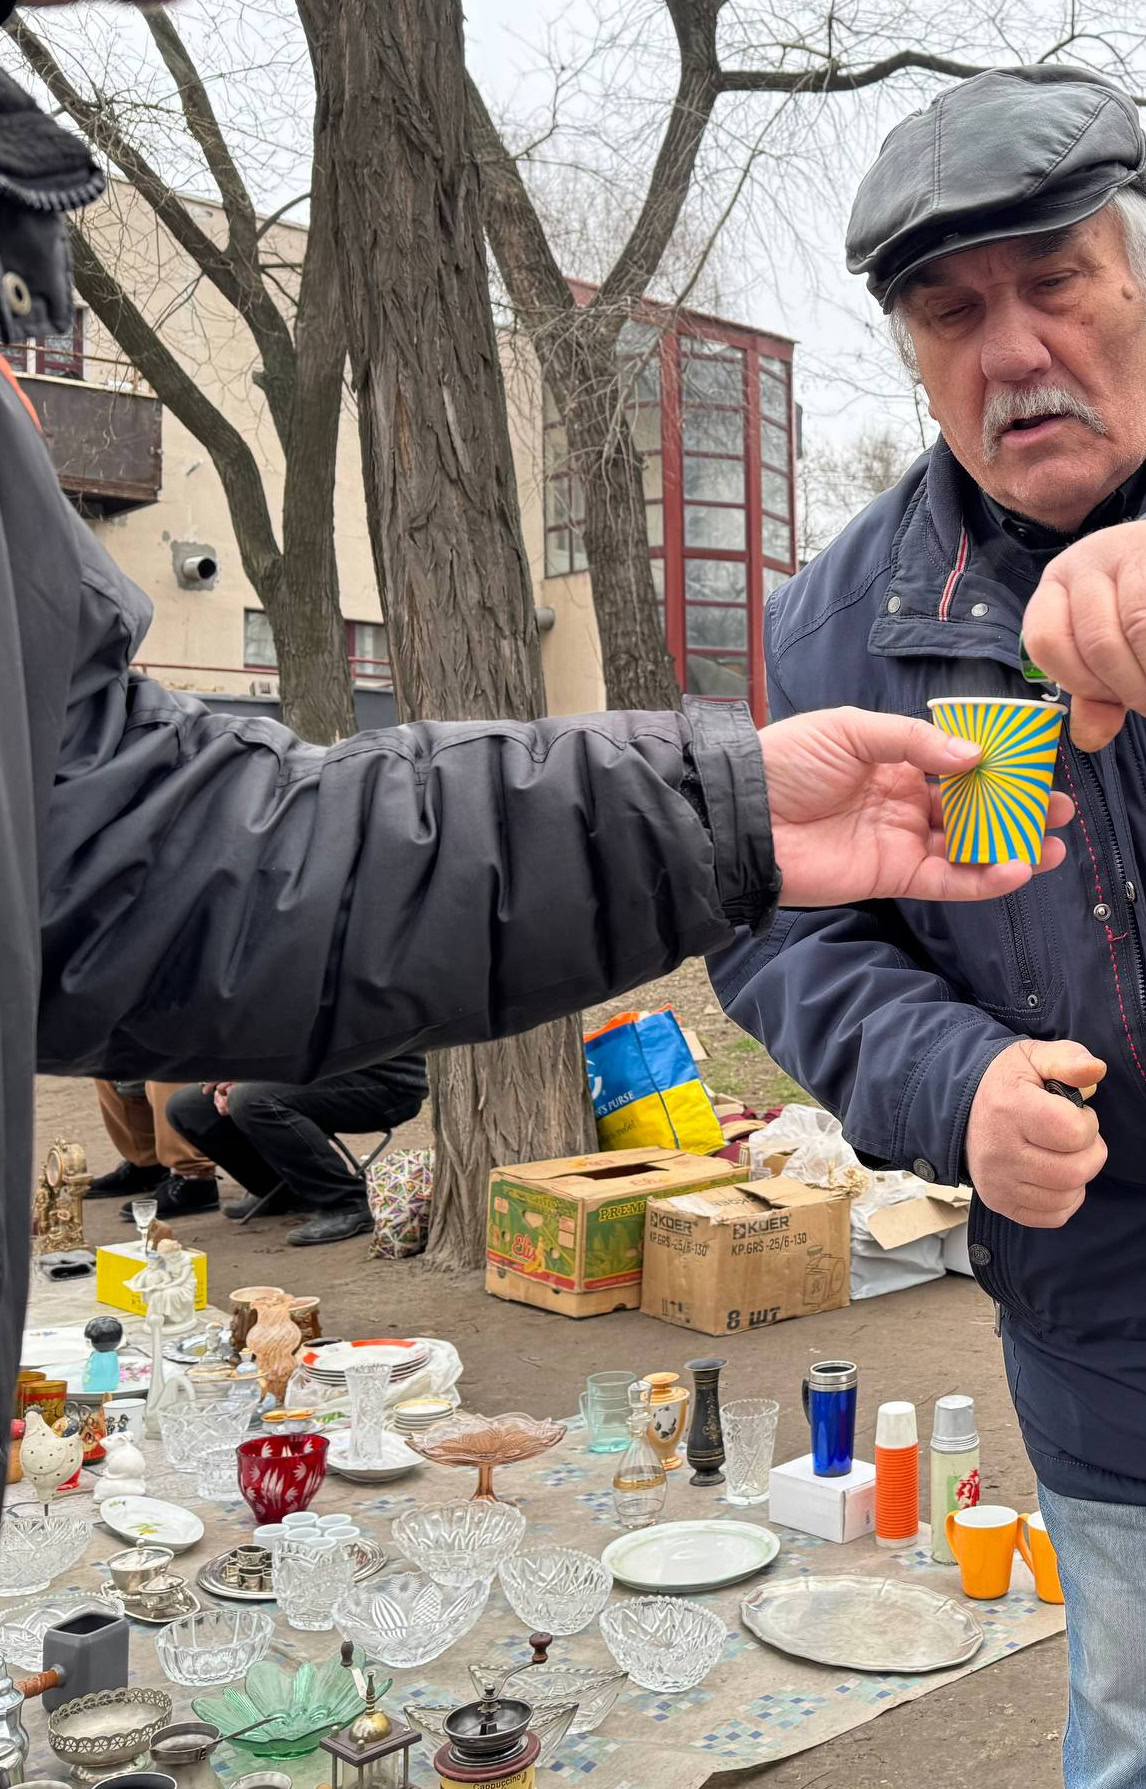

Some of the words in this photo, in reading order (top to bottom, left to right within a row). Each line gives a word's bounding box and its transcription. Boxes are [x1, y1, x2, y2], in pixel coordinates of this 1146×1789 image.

[608, 1090, 635, 1111] PURSE
[727, 1309, 741, 1331] 8
[473, 1774, 521, 1789] Cappuccino
